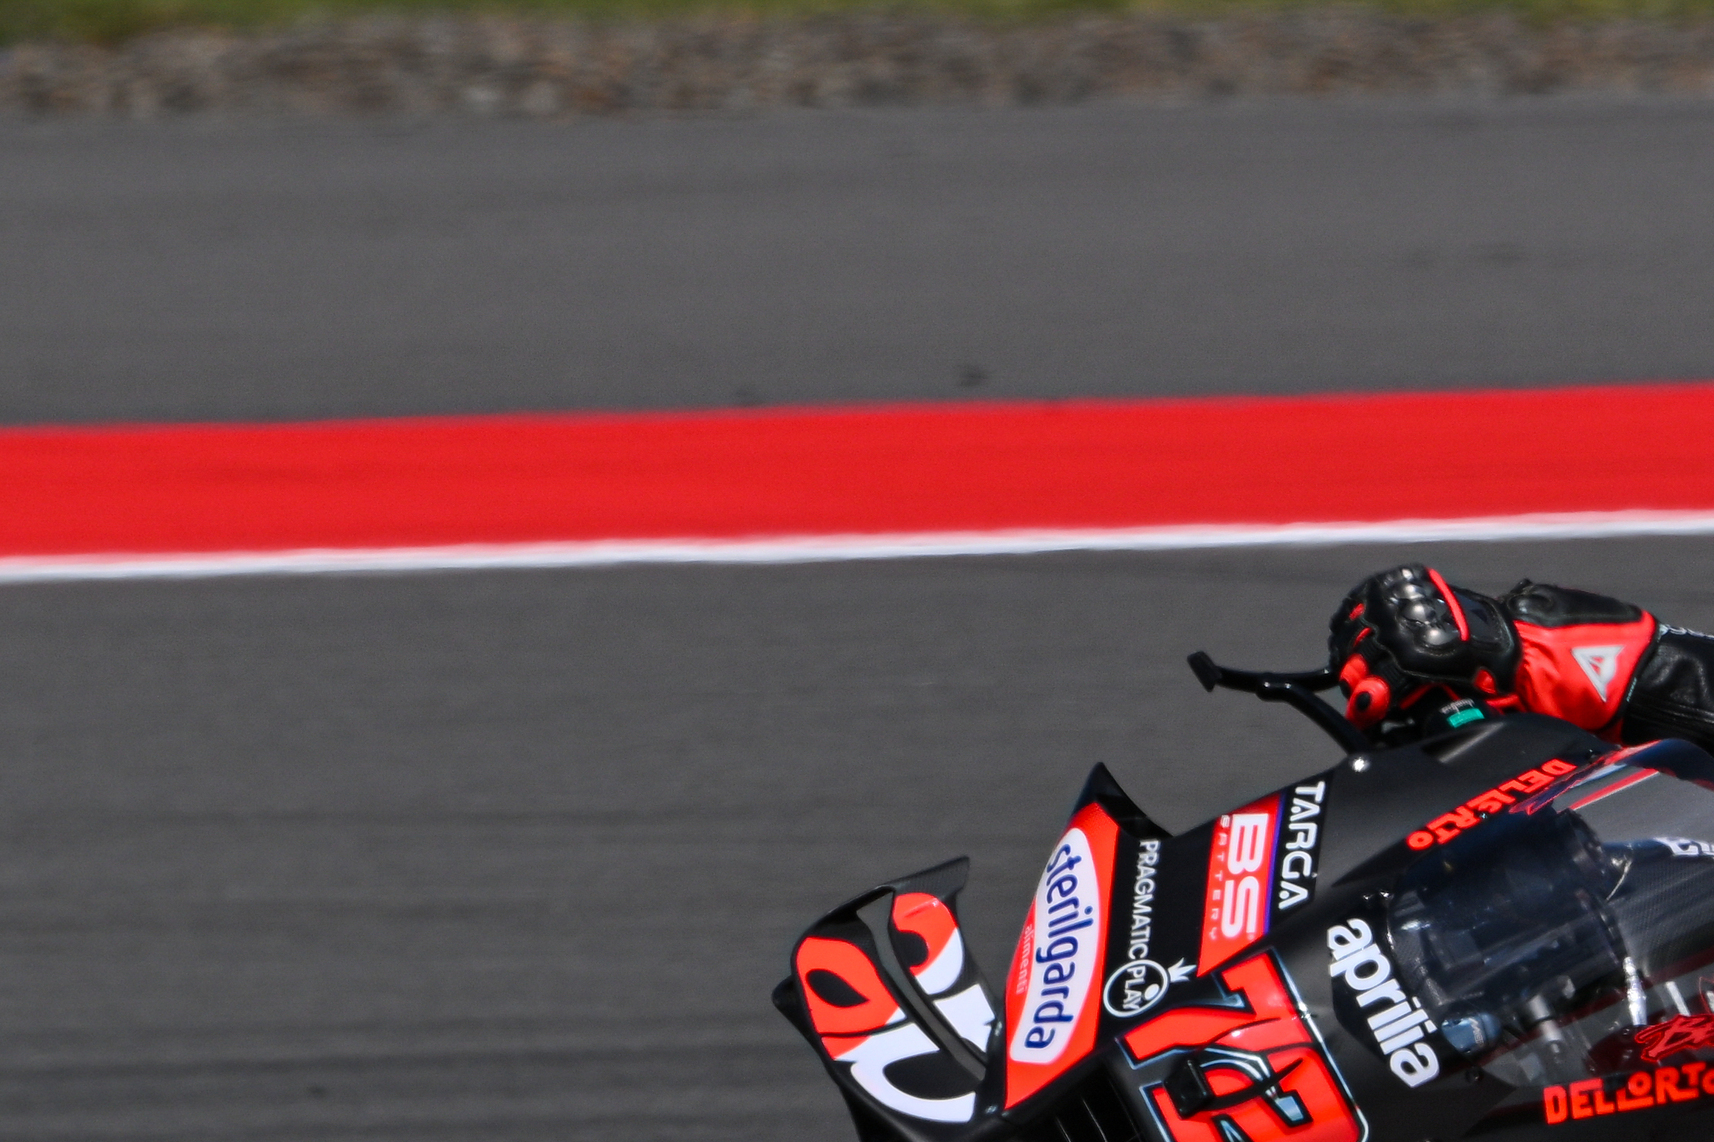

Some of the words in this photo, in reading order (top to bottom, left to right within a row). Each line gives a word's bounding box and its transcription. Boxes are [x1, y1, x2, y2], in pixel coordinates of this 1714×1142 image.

[1125, 839, 1162, 959] PRAGMATIC
[1218, 814, 1268, 938] BS
[1278, 781, 1326, 910] TARGA
[1024, 843, 1079, 1052] sterilgarda
[1120, 961, 1156, 1013] PLAY
[1327, 917, 1441, 1087] aprilia
